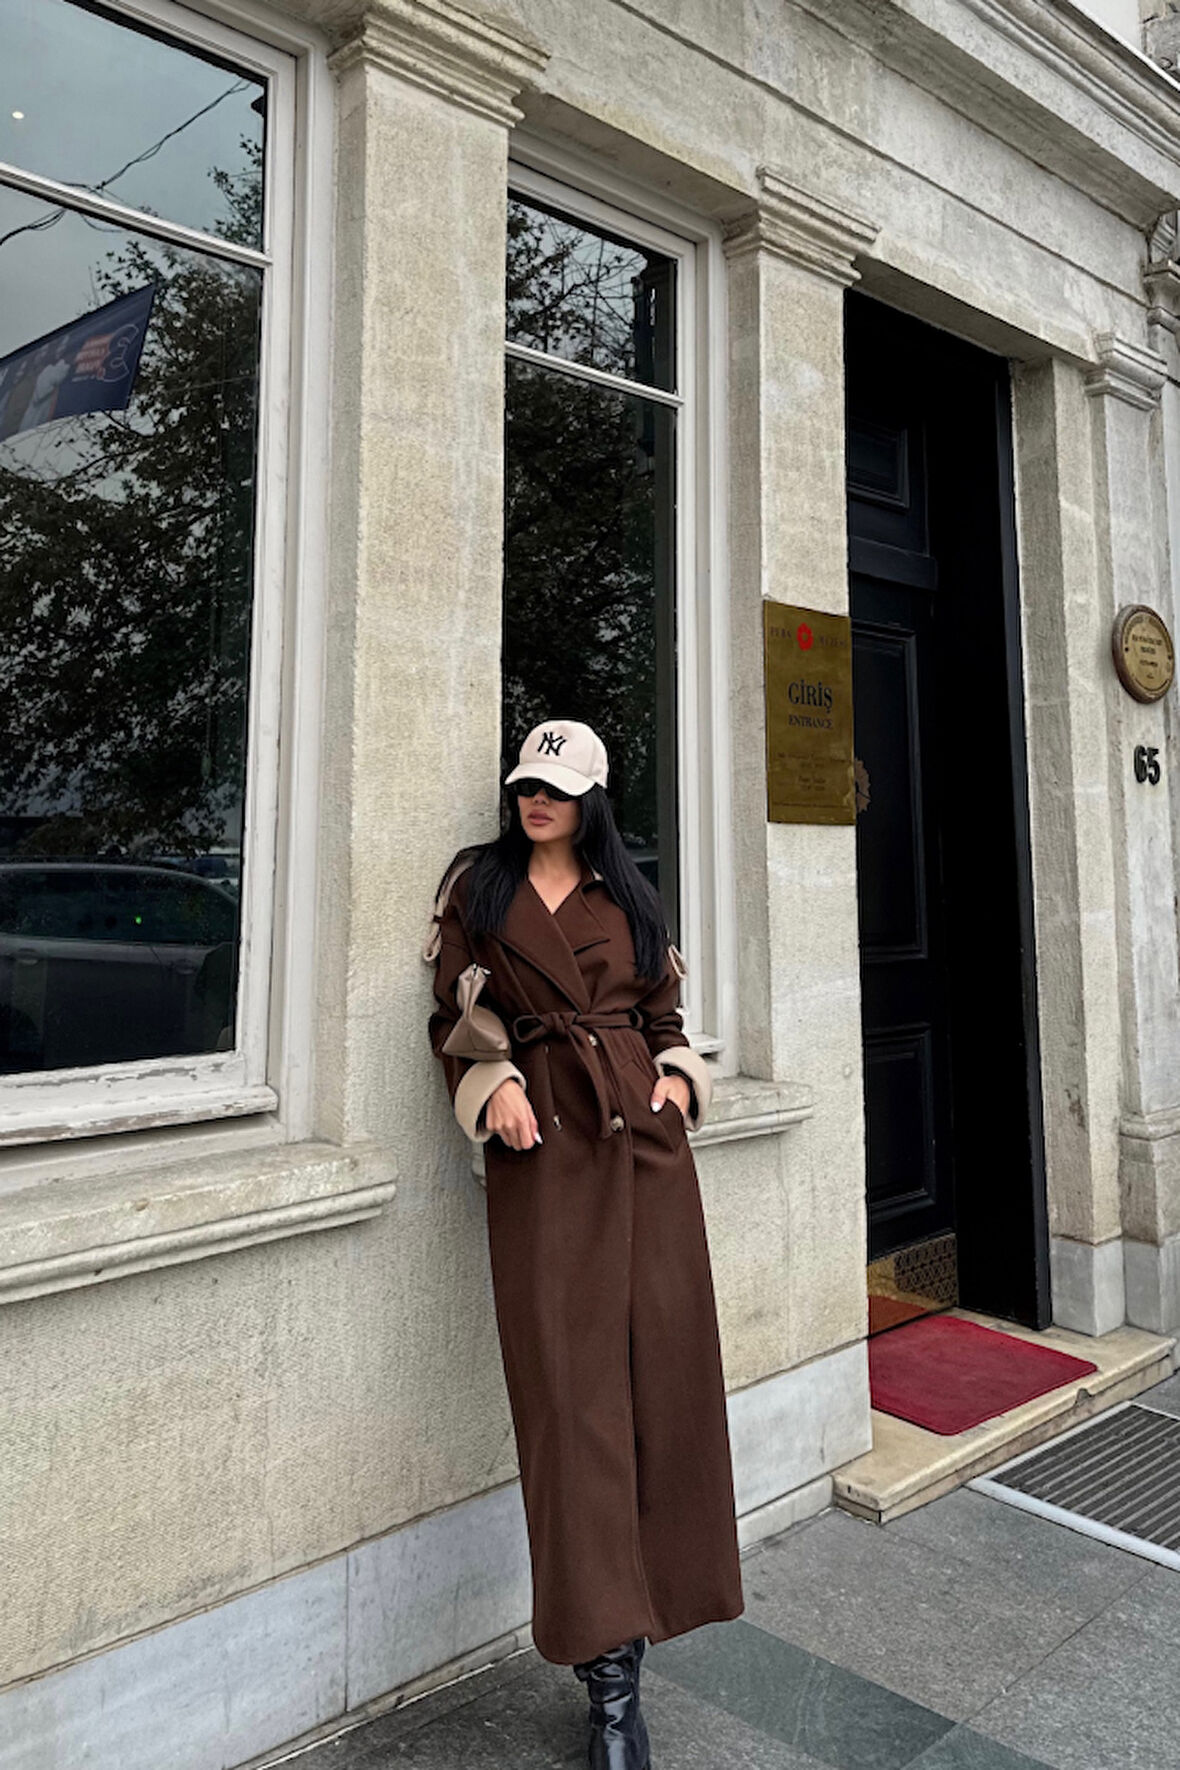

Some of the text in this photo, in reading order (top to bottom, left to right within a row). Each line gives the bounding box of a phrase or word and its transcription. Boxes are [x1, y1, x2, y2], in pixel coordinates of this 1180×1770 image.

[788, 679, 833, 714] GİRİŞ
[788, 714, 833, 729] ENTRANCE
[537, 731, 567, 756] NY
[1133, 745, 1160, 786] 65
